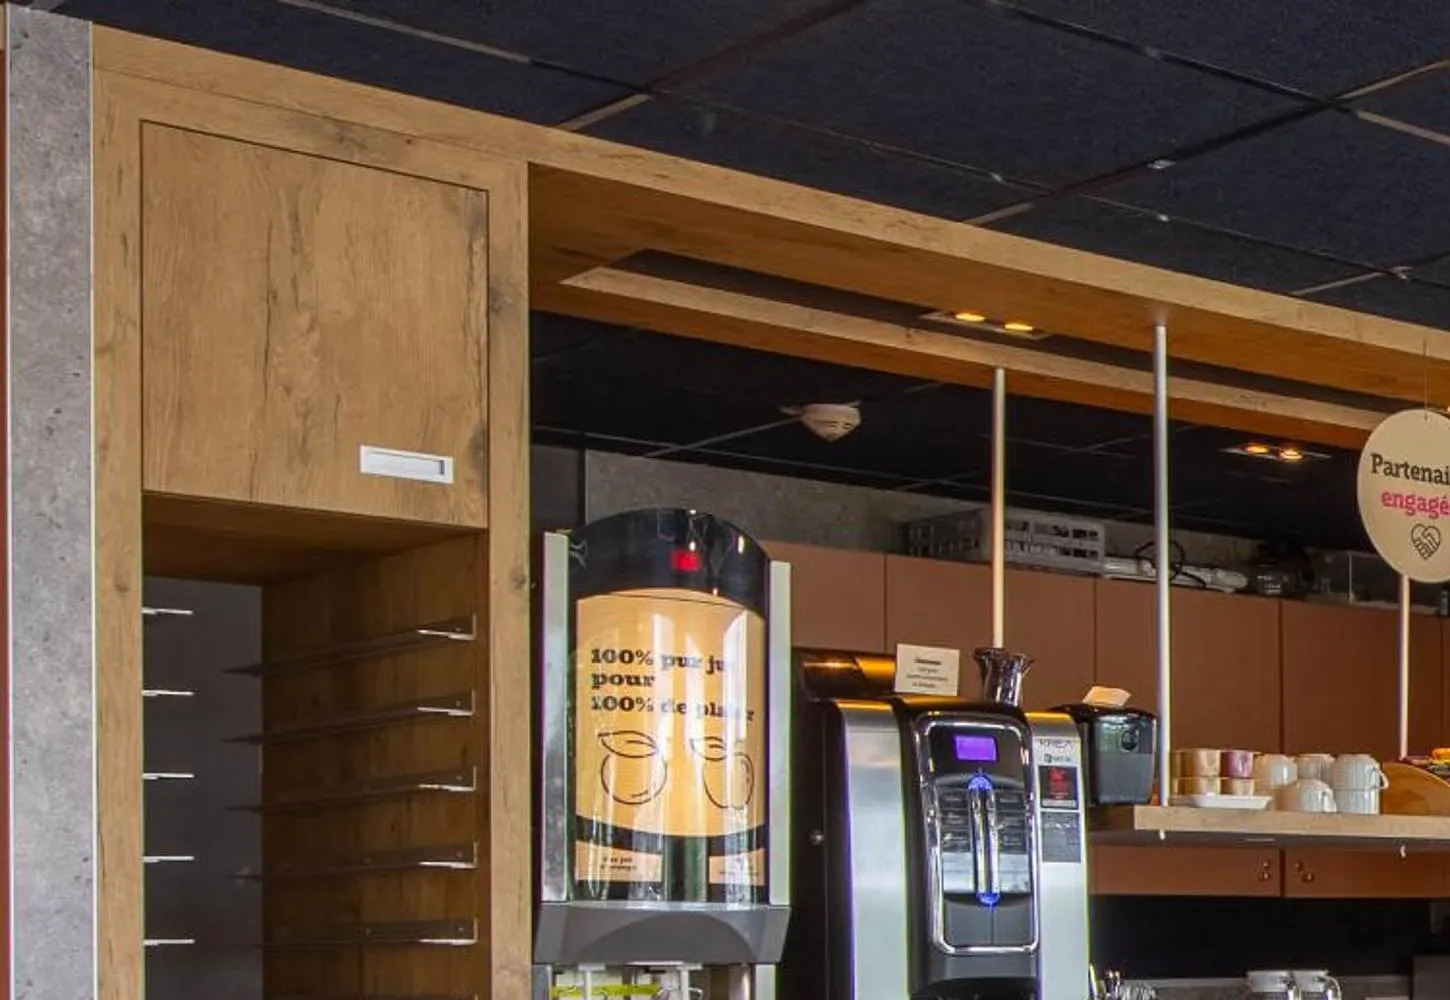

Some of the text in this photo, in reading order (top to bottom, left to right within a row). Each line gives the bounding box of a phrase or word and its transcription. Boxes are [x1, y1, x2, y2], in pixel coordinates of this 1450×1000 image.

[591, 648, 654, 666] 100%
[661, 653, 702, 671] pur
[591, 673, 655, 690] pour
[591, 695, 654, 712] 100%
[661, 698, 687, 714] de
